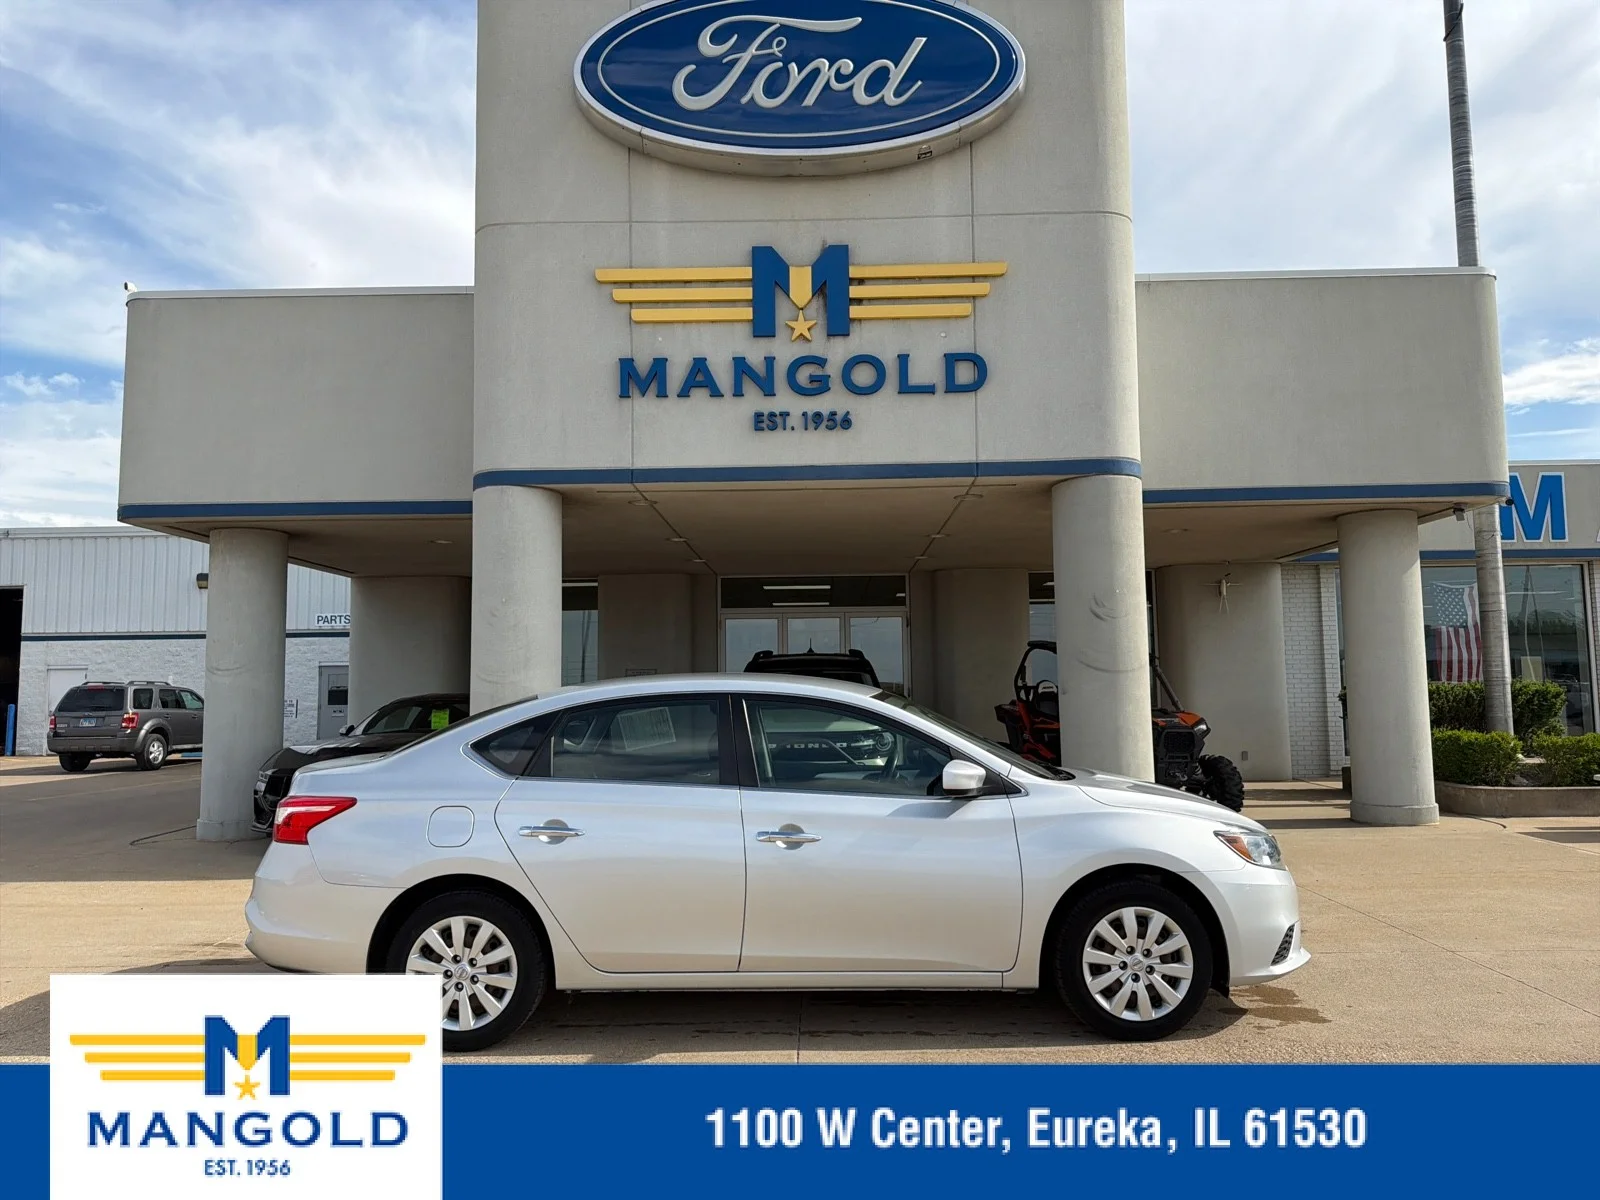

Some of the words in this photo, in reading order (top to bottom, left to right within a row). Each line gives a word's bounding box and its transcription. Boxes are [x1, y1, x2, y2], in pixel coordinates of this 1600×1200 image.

[672, 14, 928, 111] Ford
[618, 352, 988, 399] MANGOLD
[753, 411, 795, 432] EST.
[801, 410, 853, 431] 1956
[1499, 472, 1600, 543] M
[316, 614, 351, 625] PARTS
